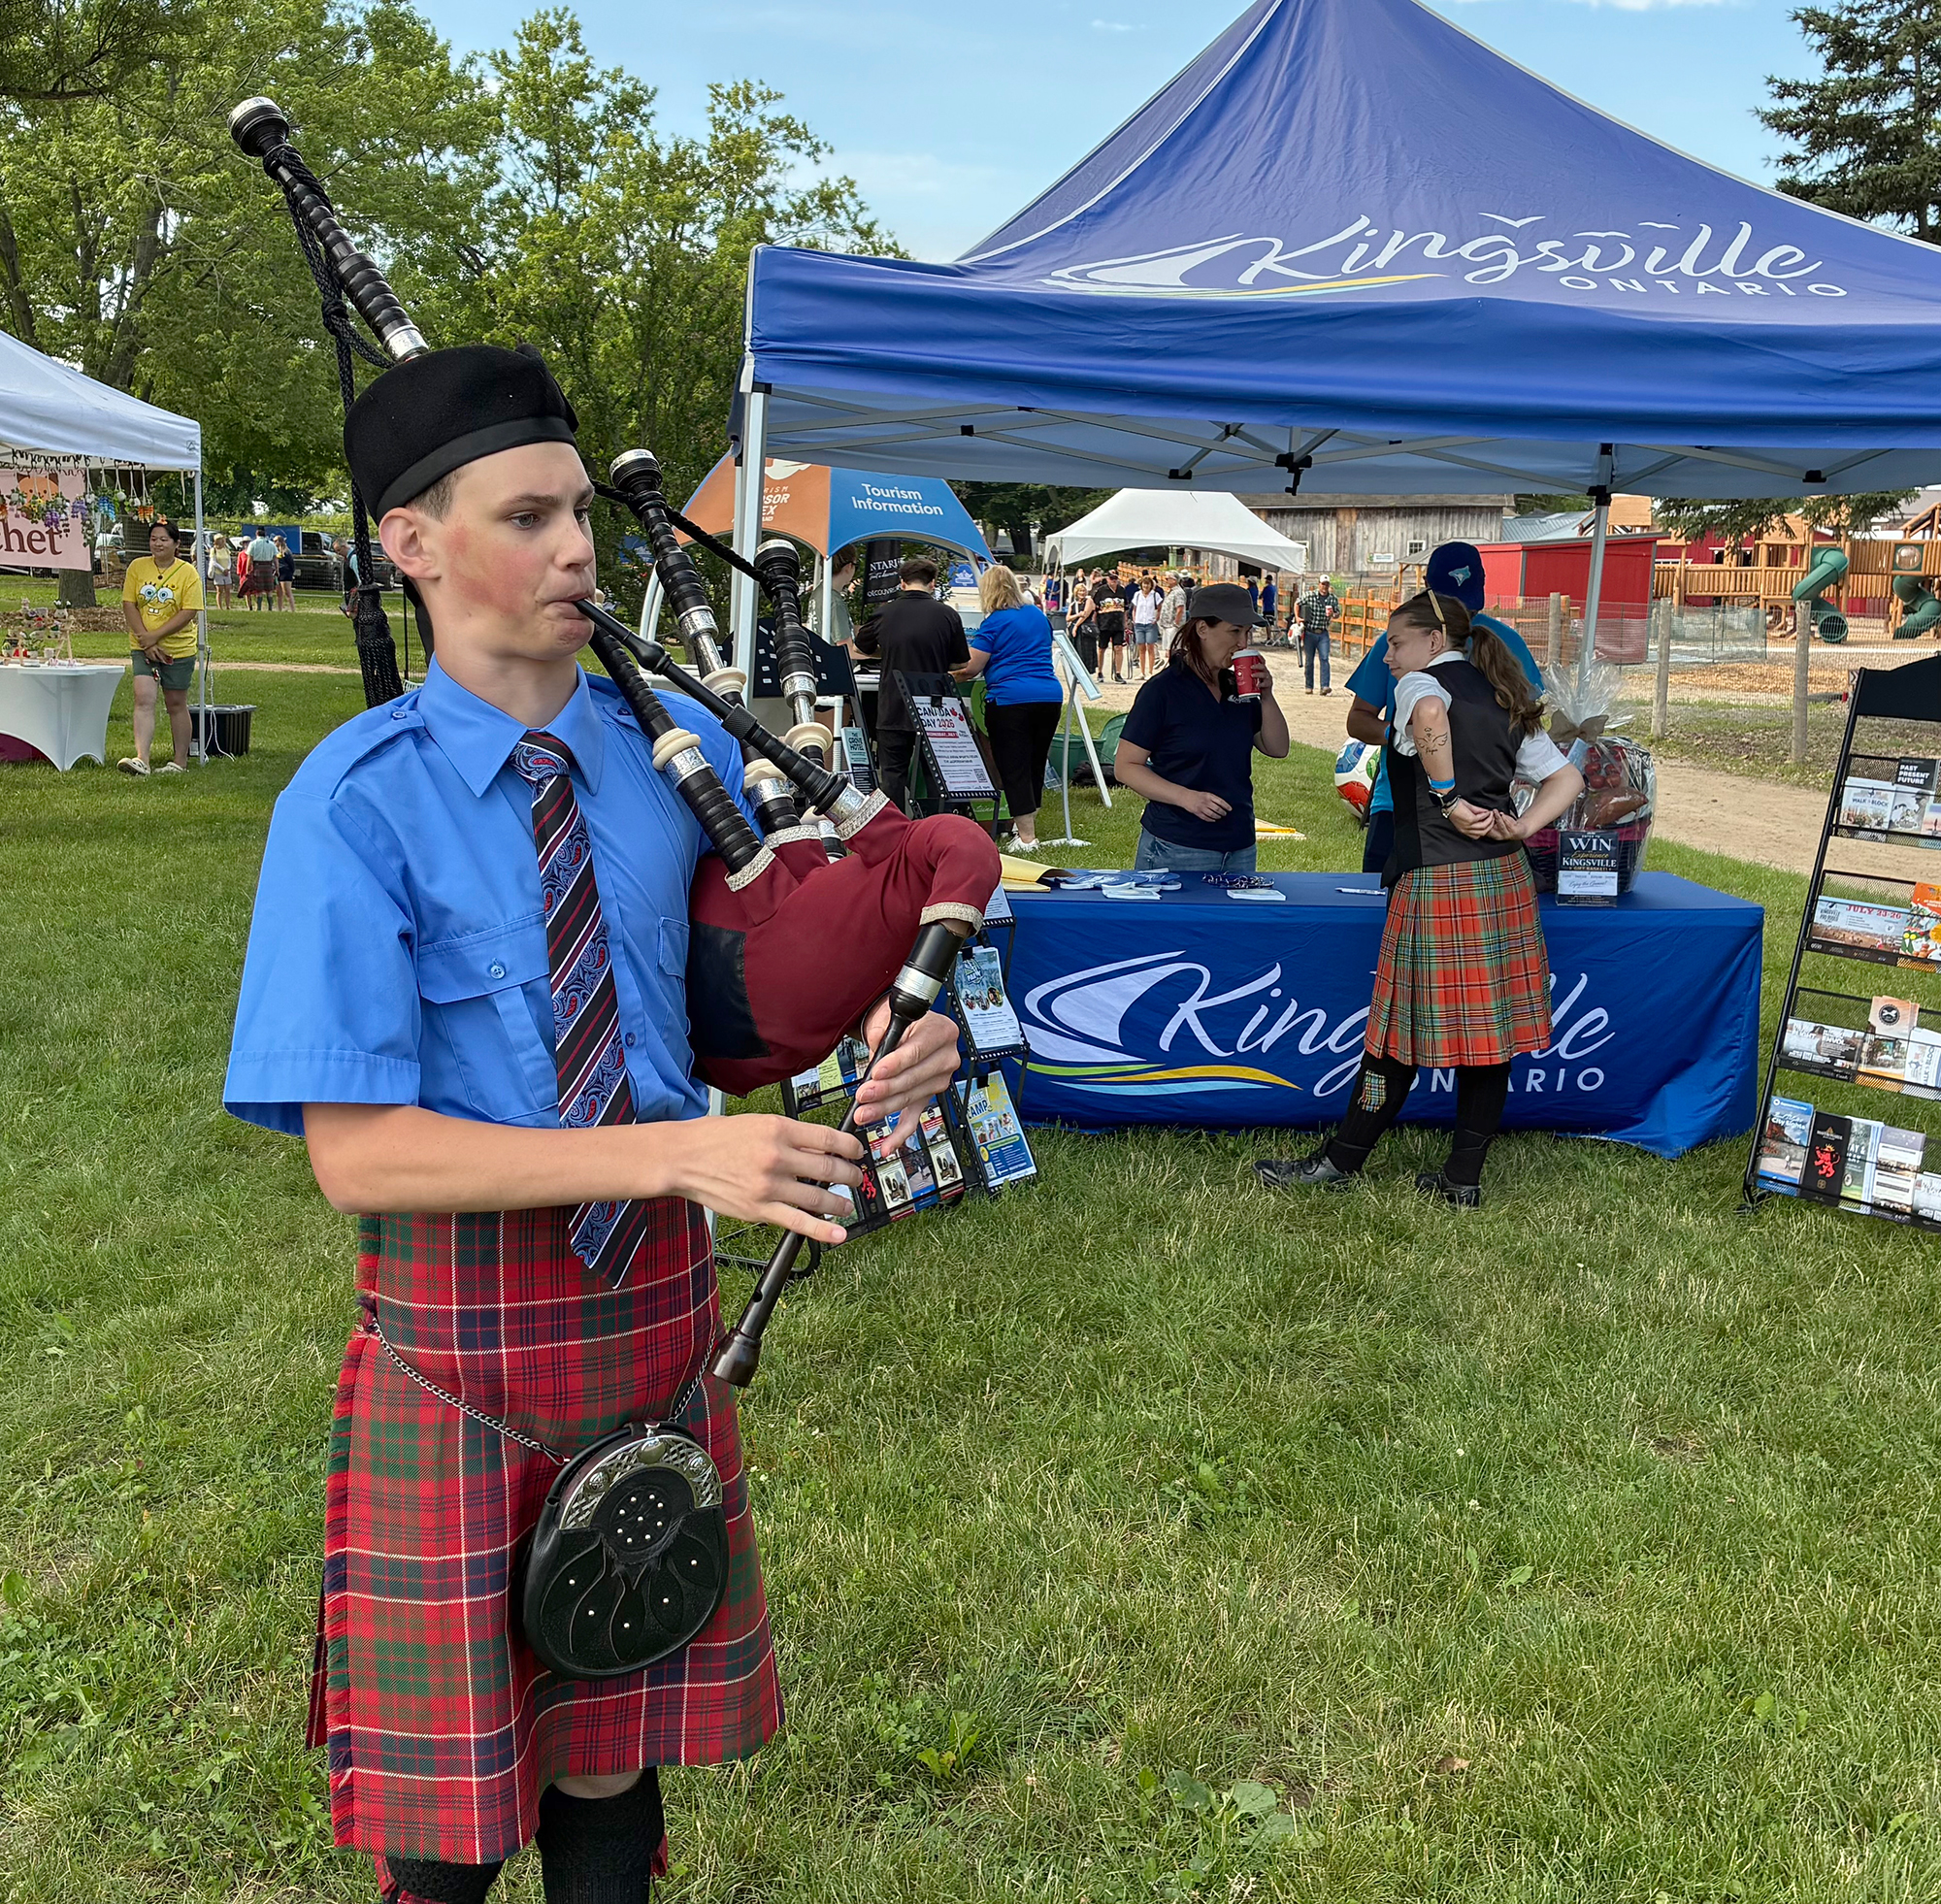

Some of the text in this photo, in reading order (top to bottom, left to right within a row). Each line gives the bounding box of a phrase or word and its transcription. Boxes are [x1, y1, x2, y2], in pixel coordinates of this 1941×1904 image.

[1236, 213, 1824, 286] Kingsville
[1559, 276, 1848, 298] ONTARIO
[861, 482, 923, 501] Tourism
[851, 496, 943, 516] Information
[0, 518, 63, 555] het
[1897, 776, 1925, 785] FUTURE
[1898, 771, 1930, 779] PRESENT
[1568, 837, 1612, 851] WIN
[1563, 857, 1617, 867] KINGSVILLE
[1845, 904, 1875, 915] JULY
[1409, 1067, 1605, 1093] NRIO
